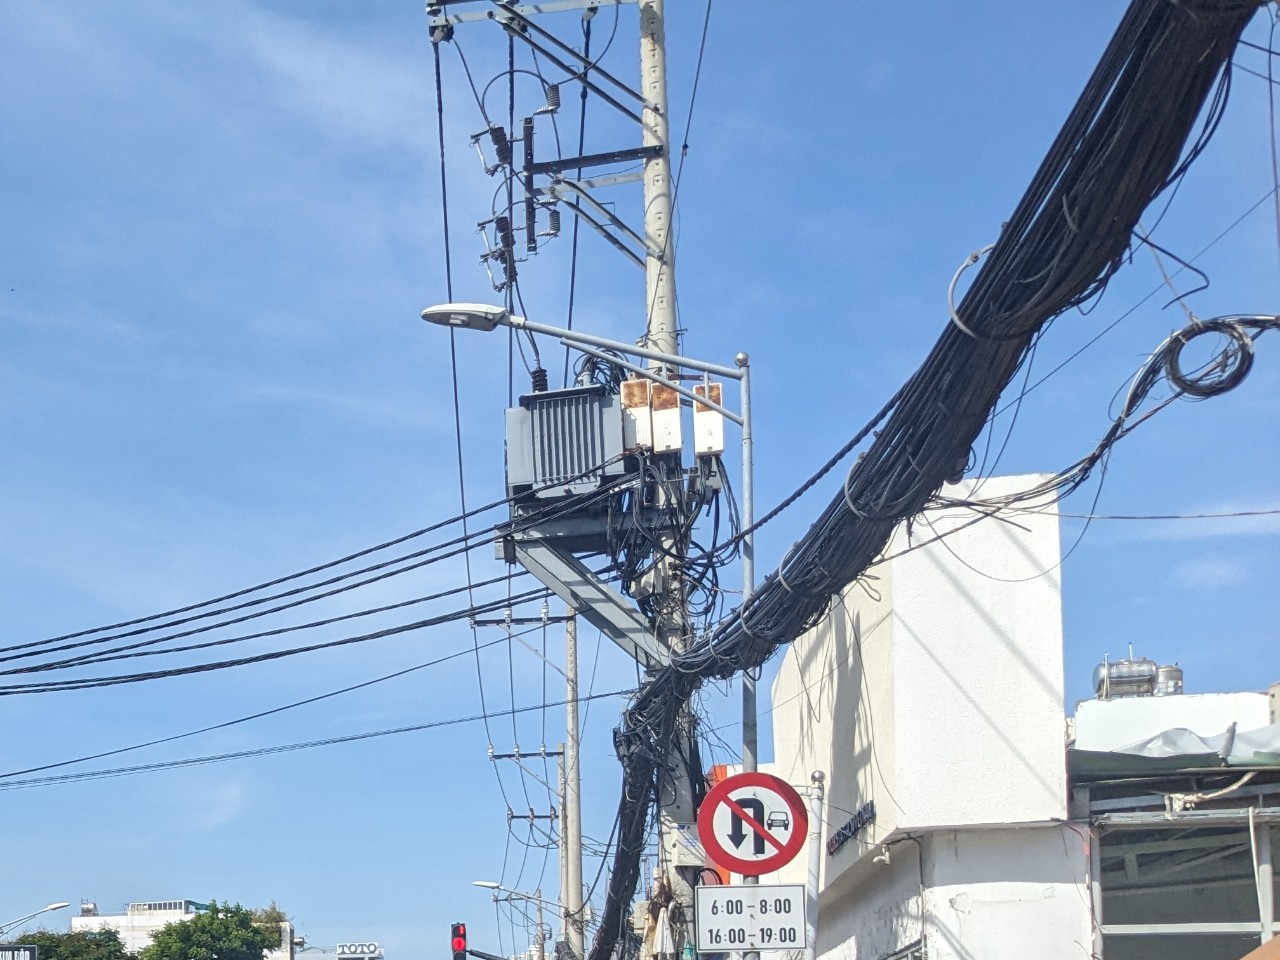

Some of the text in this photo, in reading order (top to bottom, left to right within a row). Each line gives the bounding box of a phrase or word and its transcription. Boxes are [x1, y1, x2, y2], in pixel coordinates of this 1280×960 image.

[711, 899, 743, 915] 6:00
[759, 898, 791, 914] 8:00
[707, 928, 745, 944] 16:00
[759, 927, 796, 943] 19:00
[338, 943, 378, 954] TOTO
